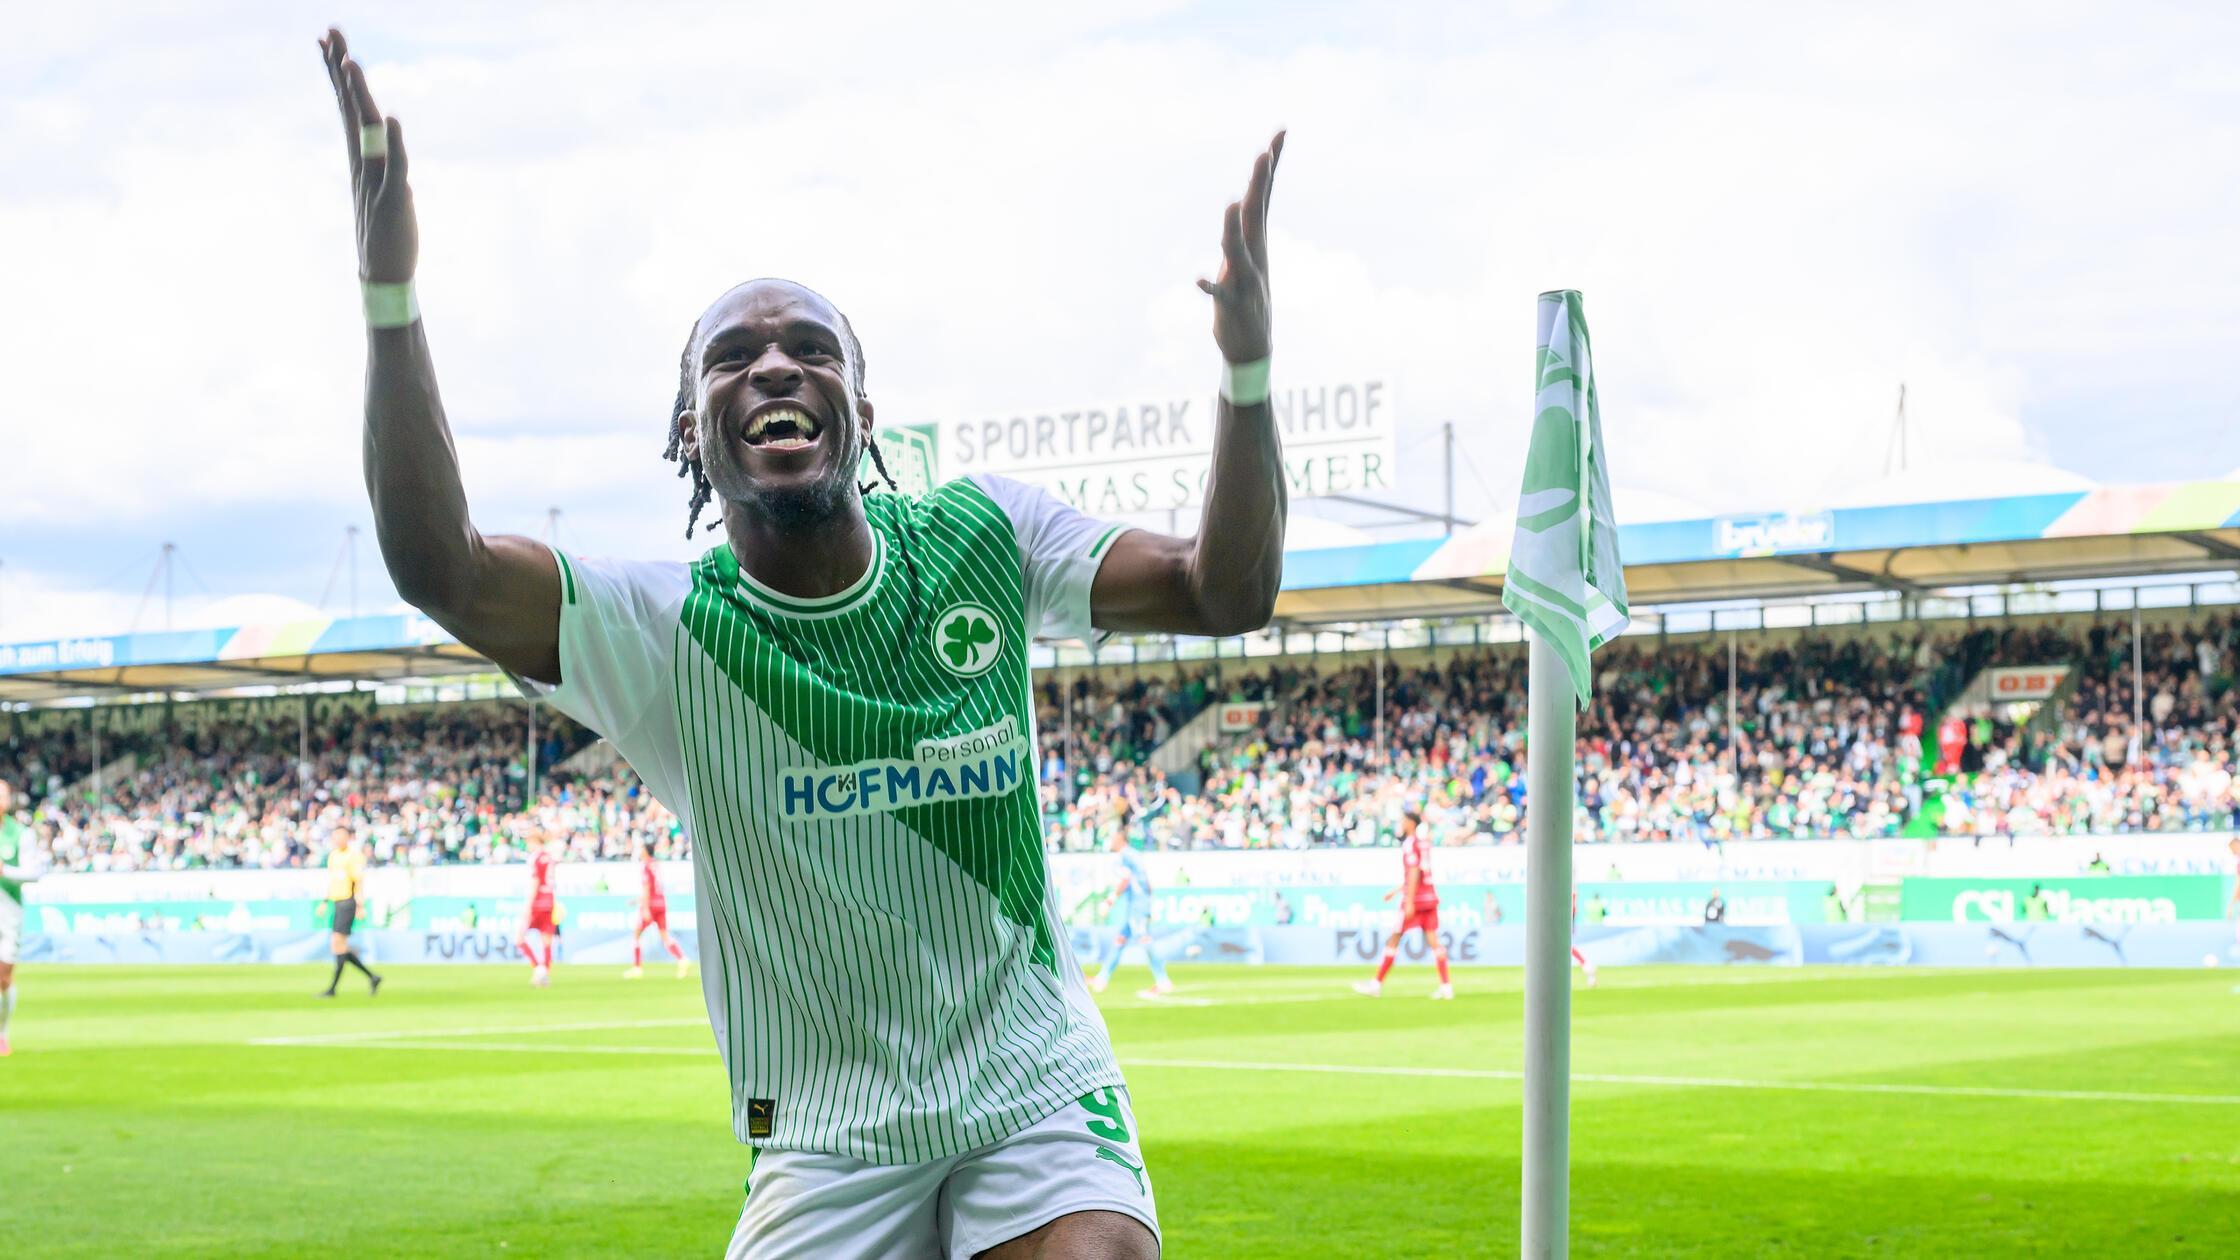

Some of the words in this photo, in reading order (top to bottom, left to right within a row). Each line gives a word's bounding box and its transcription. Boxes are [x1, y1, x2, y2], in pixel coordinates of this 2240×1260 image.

[955, 400, 1192, 464] SPORTPARK
[1172, 452, 1388, 507] SMER
[922, 721, 1016, 764] Personal
[784, 748, 1017, 816] HOFMANN
[1335, 928, 1479, 960] FUURE
